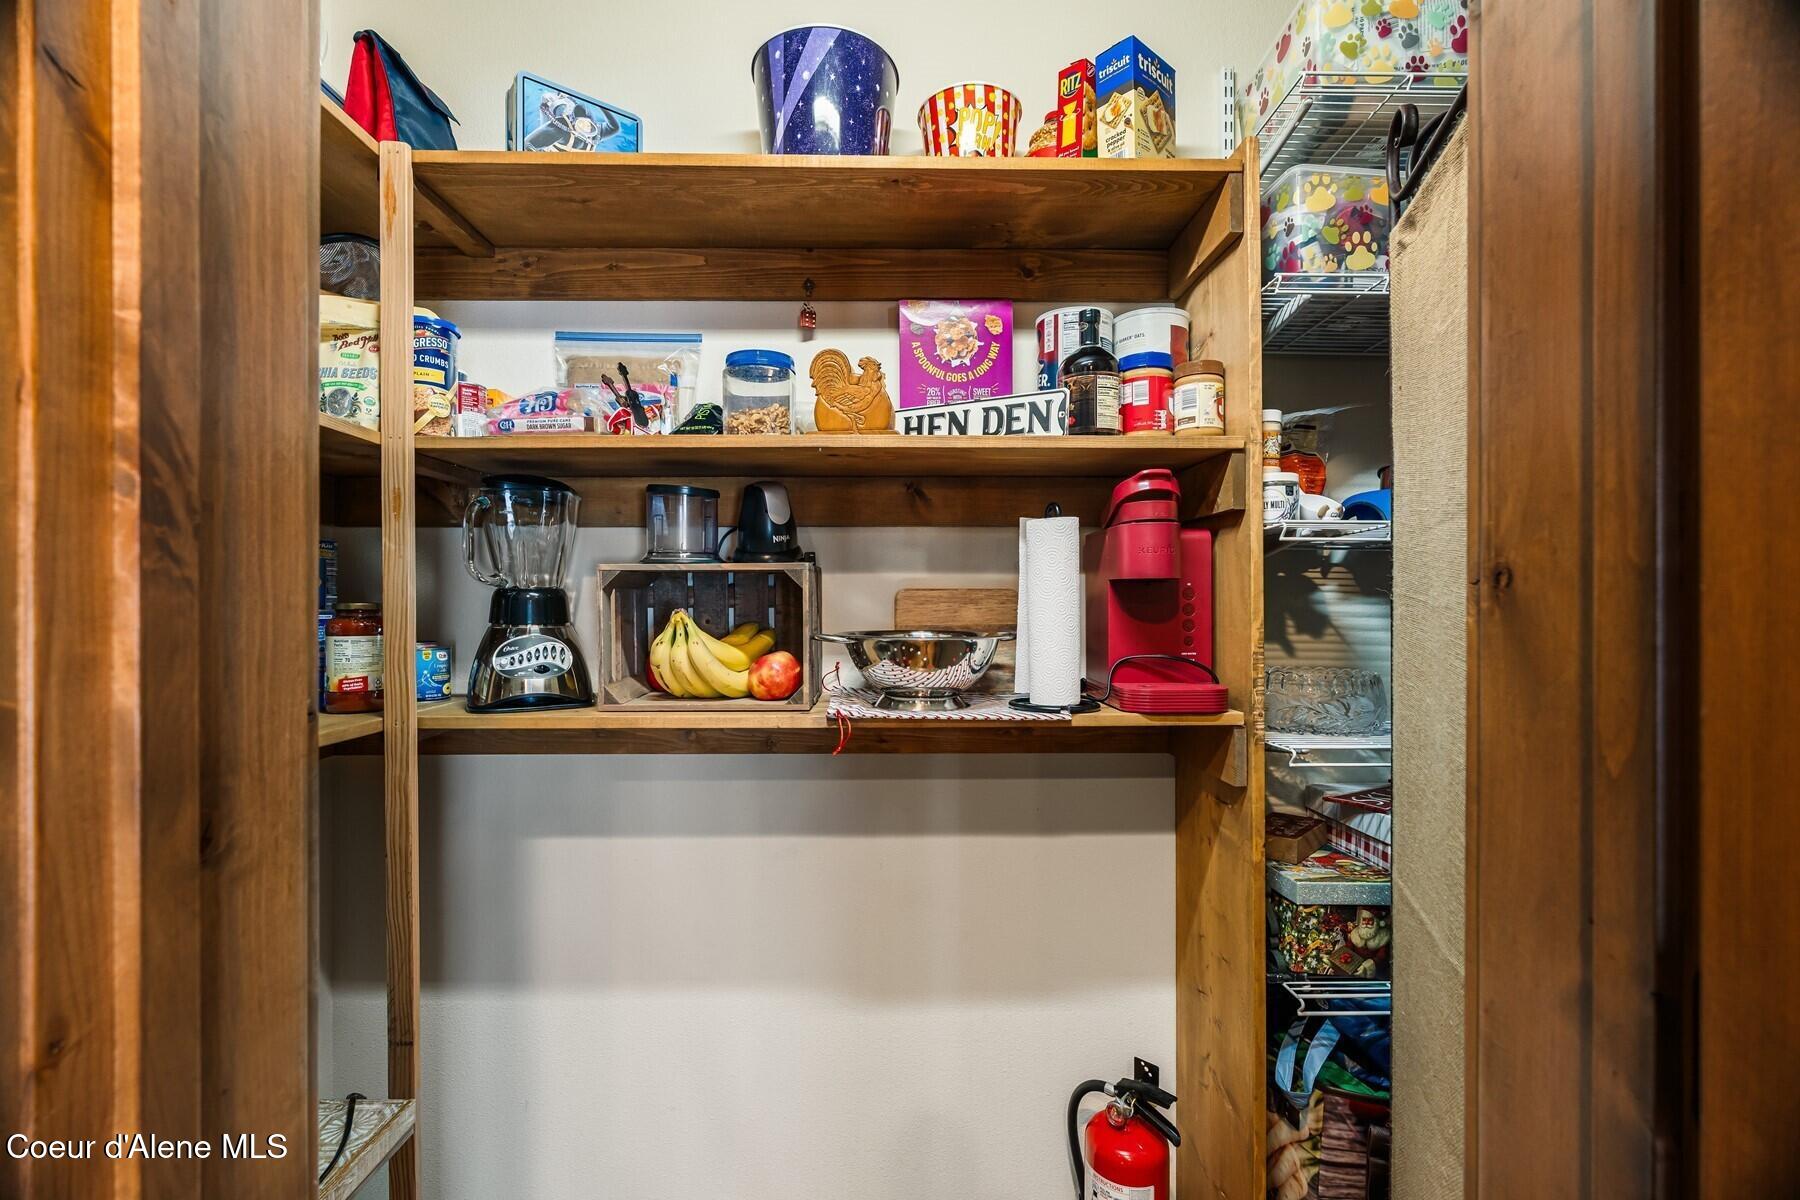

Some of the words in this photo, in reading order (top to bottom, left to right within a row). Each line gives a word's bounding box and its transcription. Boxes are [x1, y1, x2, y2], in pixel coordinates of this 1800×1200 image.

[1099, 56, 1130, 79] triscuit
[1138, 53, 1173, 94] triscuit
[1061, 73, 1082, 95] RITZ
[1106, 128, 1127, 143] cracked
[1107, 135, 1126, 149] pepper
[338, 338, 360, 351] Red
[414, 337, 448, 349] GRESSO
[420, 354, 449, 368] CRUMBS
[914, 348, 945, 380] SPOONFUL
[946, 372, 967, 383] GOES
[968, 371, 975, 381] A
[974, 359, 993, 377] LONG
[988, 341, 1000, 360] WAY
[320, 367, 338, 378] HIA
[341, 367, 378, 380] SEEDS
[927, 387, 941, 396] 26%
[973, 388, 991, 397] SWEET
[904, 409, 971, 435] HEN
[982, 399, 1054, 435] DEN
[1271, 500, 1285, 509] MULTI
[773, 534, 791, 544] NINJA
